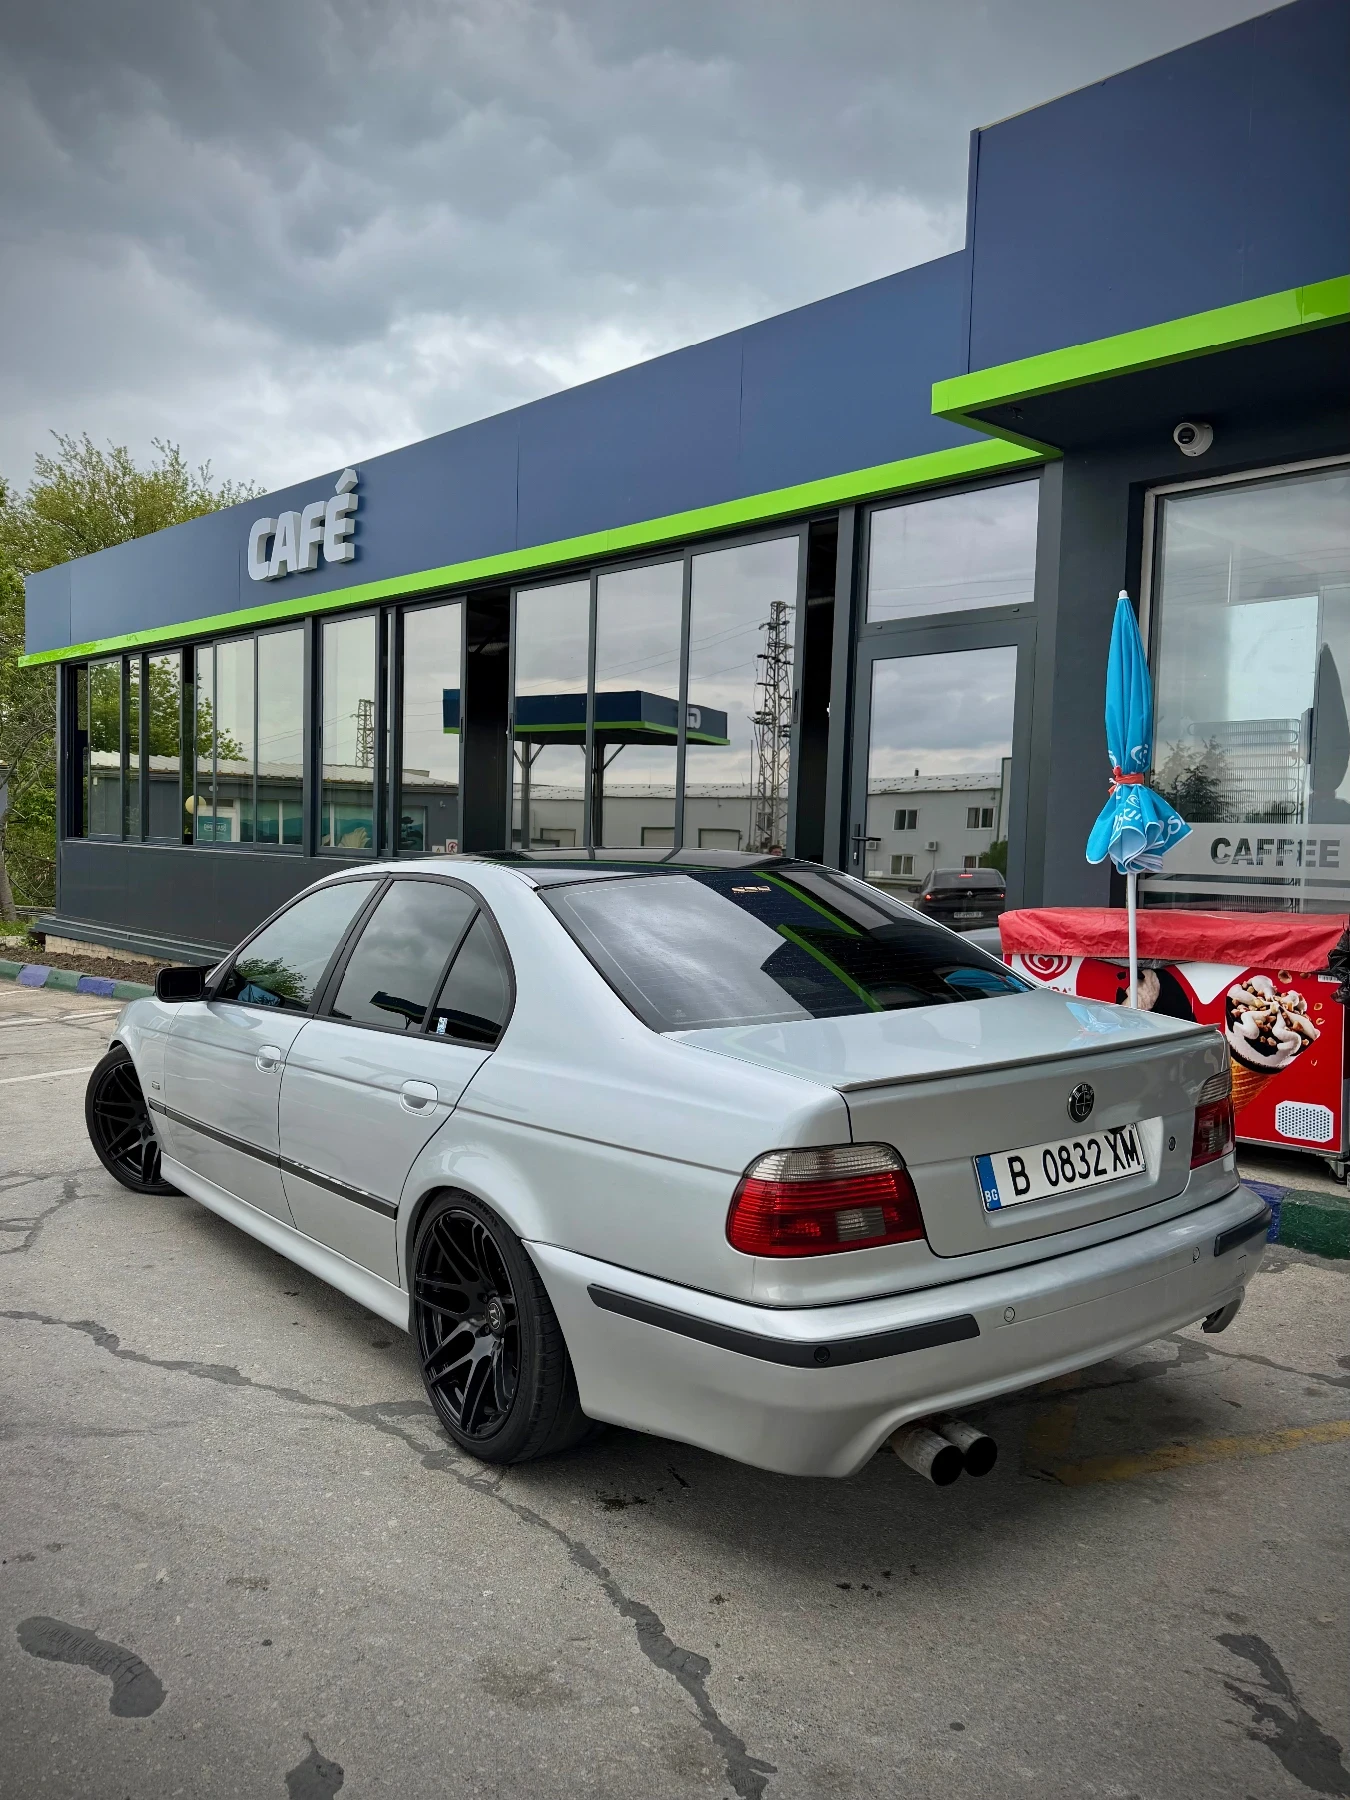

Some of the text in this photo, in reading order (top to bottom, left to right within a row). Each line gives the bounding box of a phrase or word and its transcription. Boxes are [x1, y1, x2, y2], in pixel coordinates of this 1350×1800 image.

[247, 468, 358, 581] CAFÉ
[1210, 837, 1340, 868] CAFFEE
[1007, 1129, 1141, 1197] B 0832 XM
[985, 1189, 999, 1202] BG
